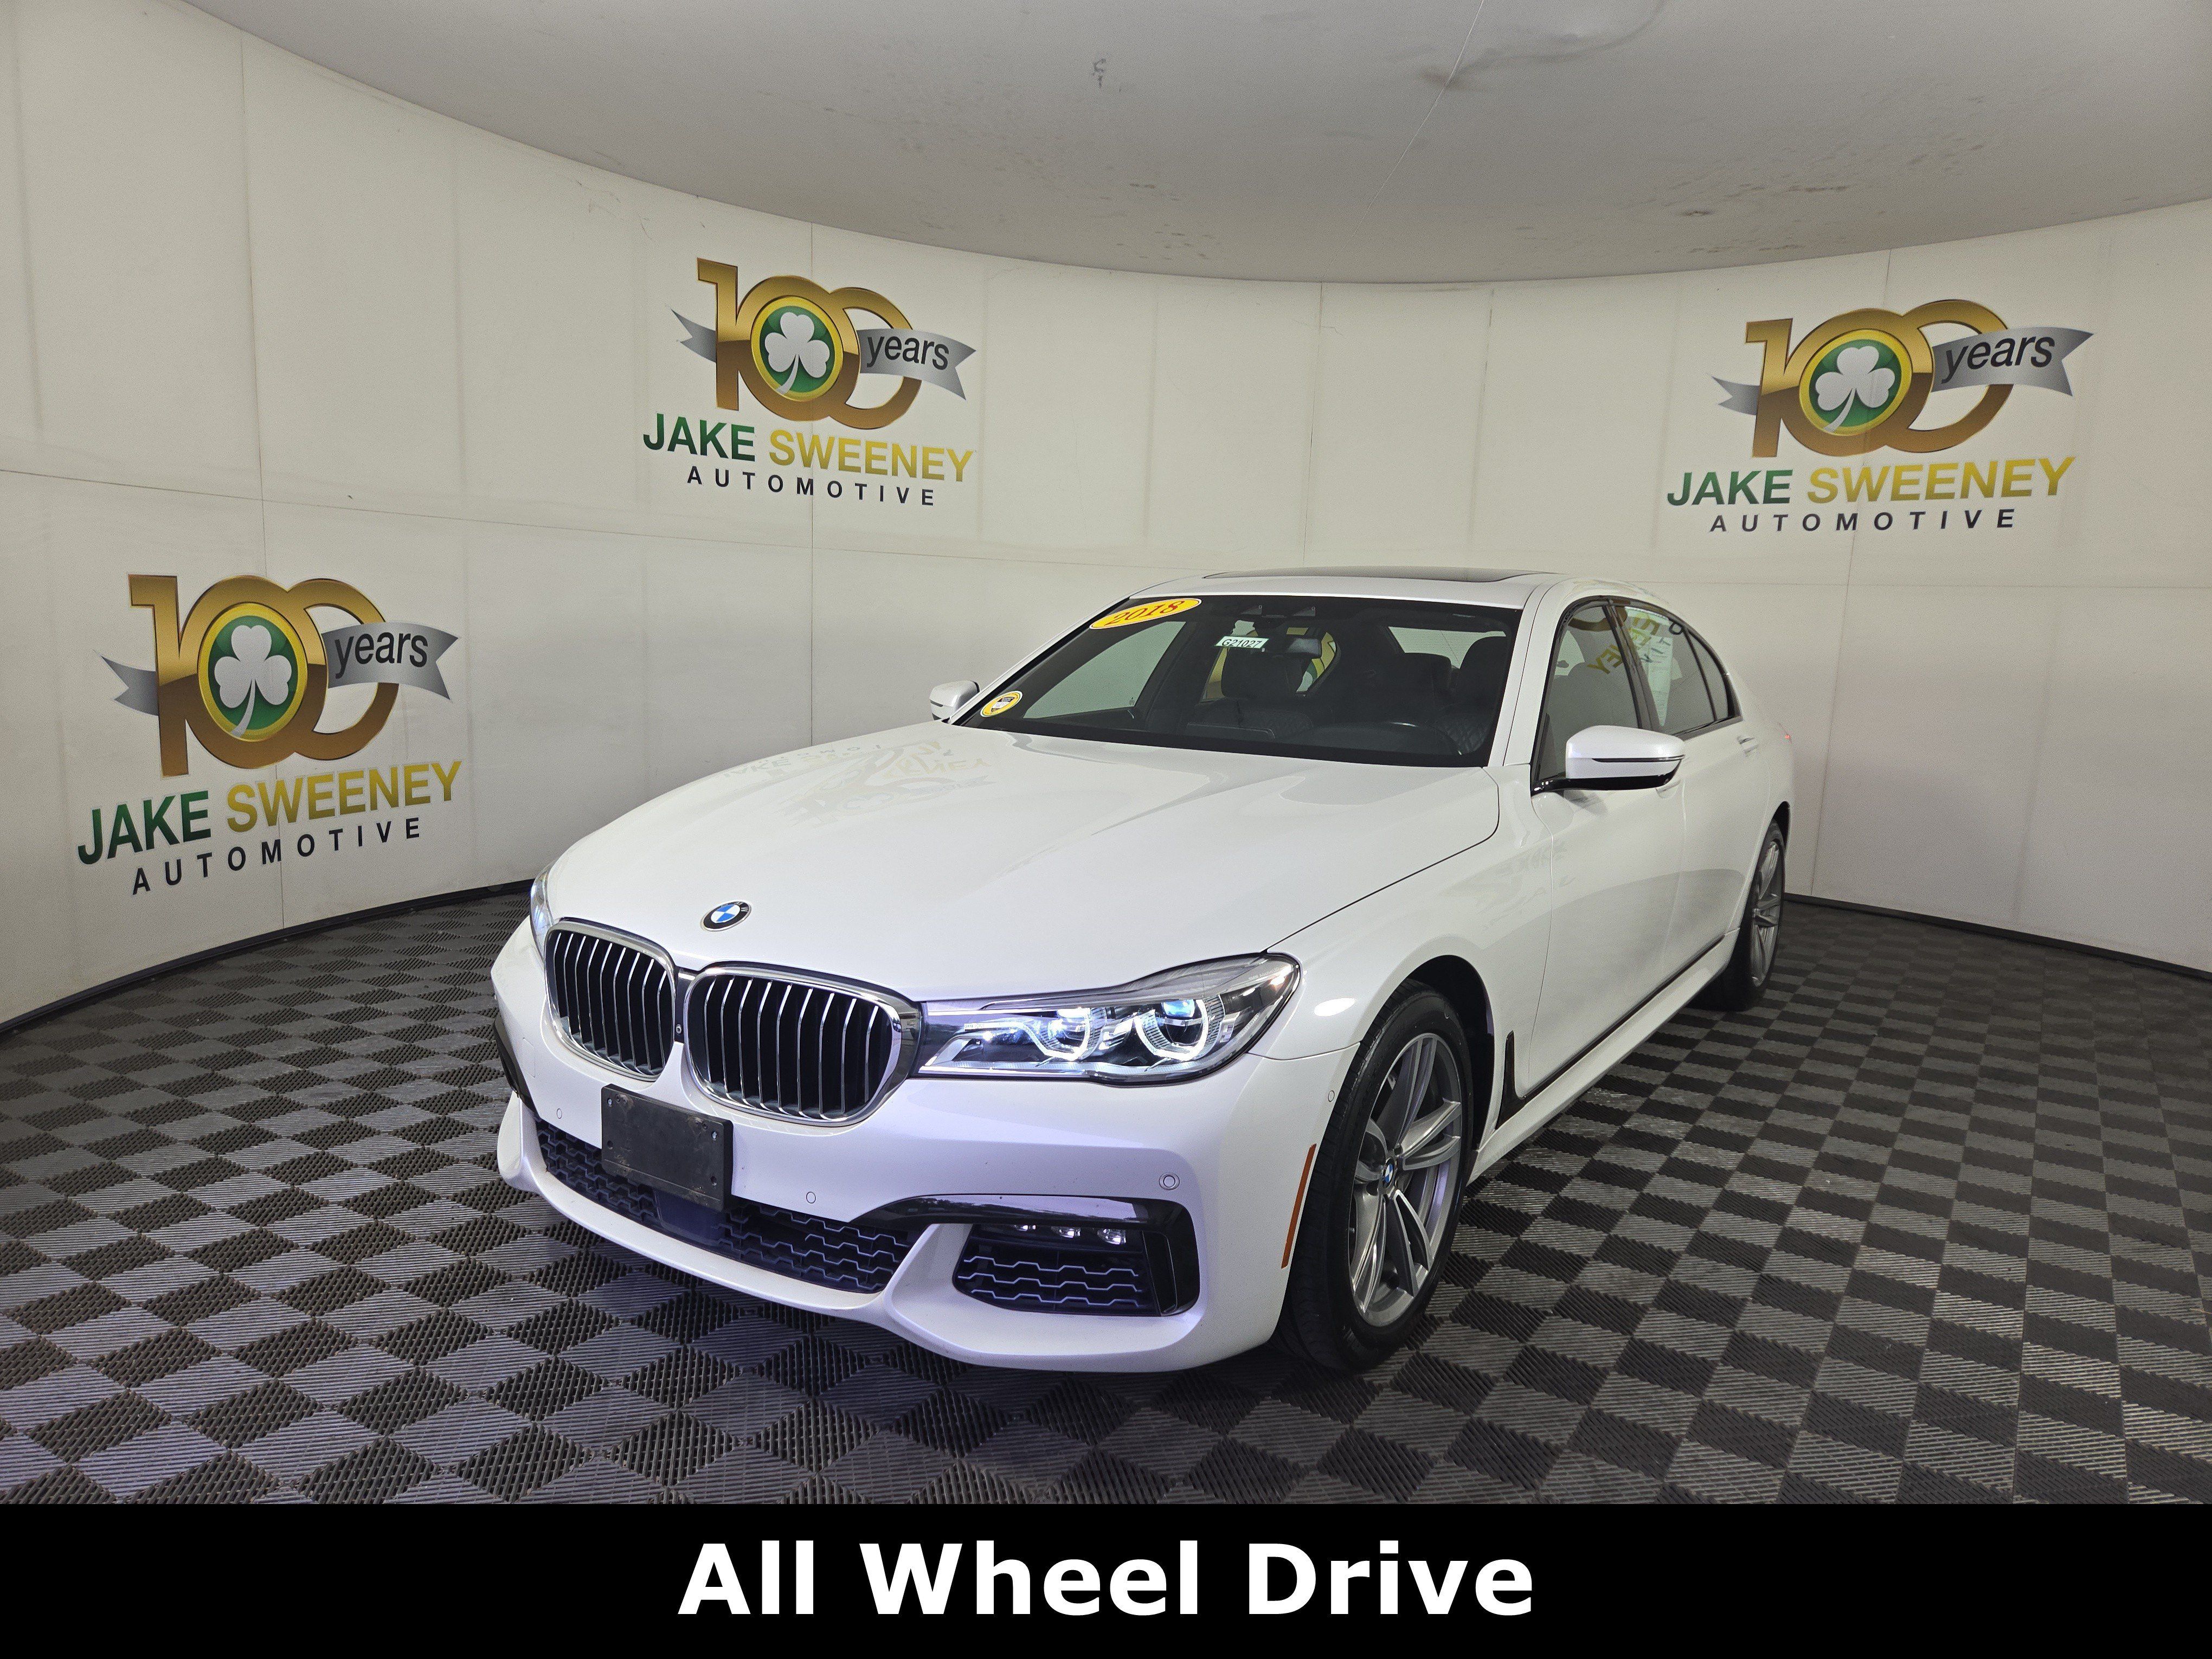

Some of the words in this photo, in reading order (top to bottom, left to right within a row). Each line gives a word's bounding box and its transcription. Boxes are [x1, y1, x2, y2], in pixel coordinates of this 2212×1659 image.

[697, 258, 922, 430] 100
[866, 333, 949, 371] years
[1745, 299, 2015, 458] 100
[1940, 335, 2055, 384] years
[643, 413, 755, 462] JAKE
[769, 429, 974, 482] SWEENEY
[1667, 468, 1793, 506] JAKE
[1807, 456, 2076, 504] SWEENEY
[687, 466, 934, 506] AUTOMOTIVE
[1709, 508, 2016, 533] AUTOMOTIVE
[1104, 601, 1185, 626] 2018
[1221, 638, 1263, 648] G21027
[128, 574, 400, 779] 100
[335, 630, 428, 679] years
[78, 790, 211, 866] JAKE
[226, 760, 462, 833] SWEENEY
[132, 816, 420, 896] AUTOMOTIVE
